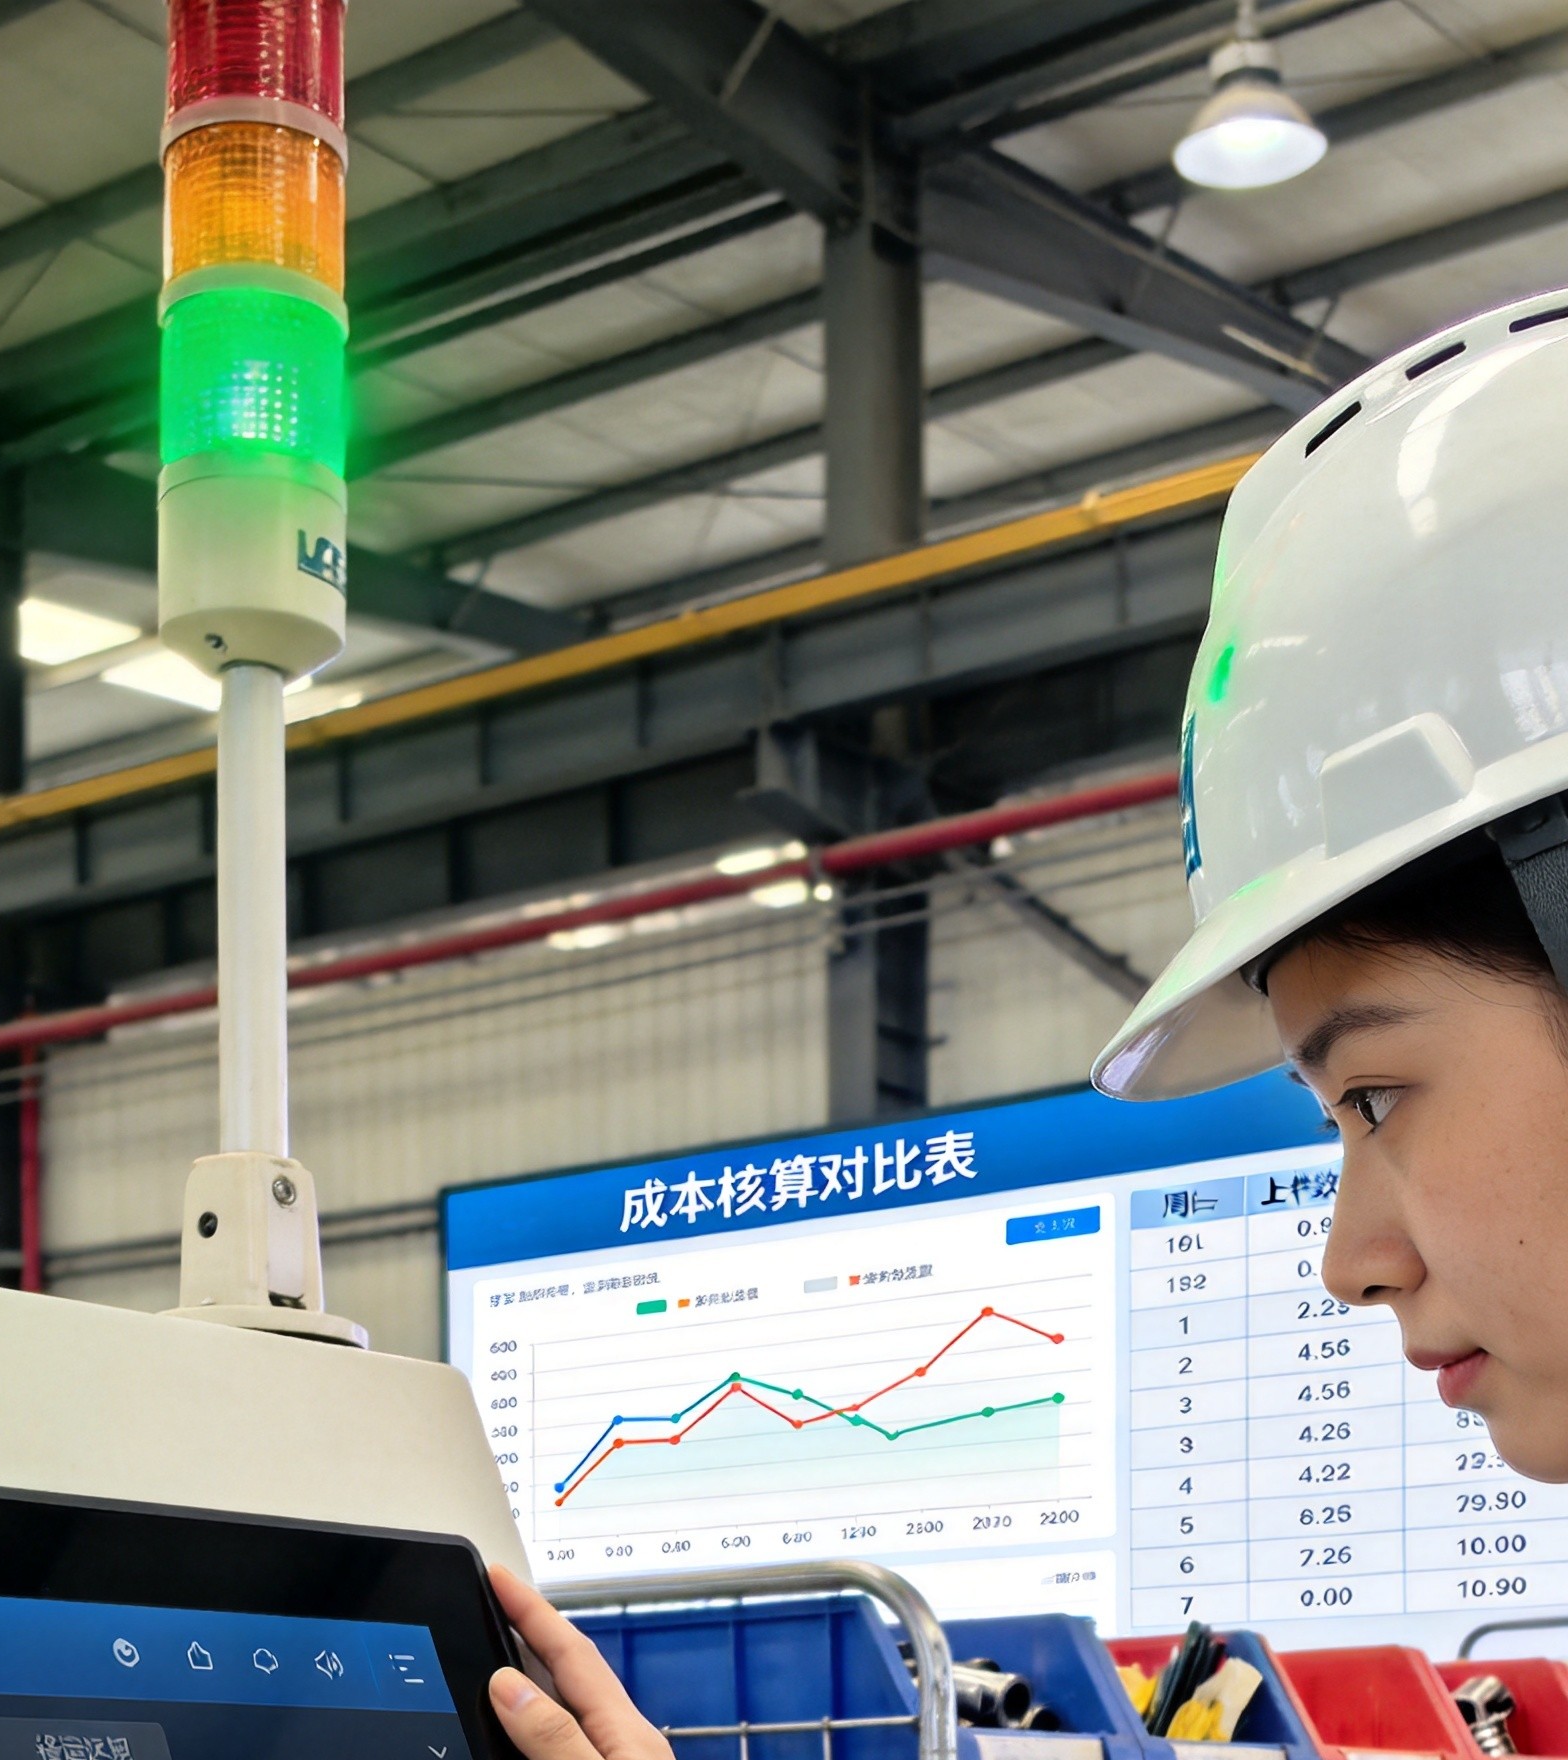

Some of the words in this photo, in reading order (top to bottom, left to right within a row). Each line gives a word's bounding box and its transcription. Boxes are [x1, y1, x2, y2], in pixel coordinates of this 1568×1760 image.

[619, 1129, 979, 1233] 成本核算对比表
[1178, 1316, 1190, 1335] 1
[1177, 1357, 1193, 1375] 2
[1179, 1396, 1193, 1414] 3
[1178, 1476, 1194, 1495] 4
[1298, 1462, 1352, 1484] 4.22
[1179, 1515, 1194, 1535] 5
[1179, 1556, 1195, 1574] 6
[1457, 1534, 1527, 1556] 10.00
[1180, 1596, 1194, 1615] 7
[1300, 1586, 1353, 1607] 0.00
